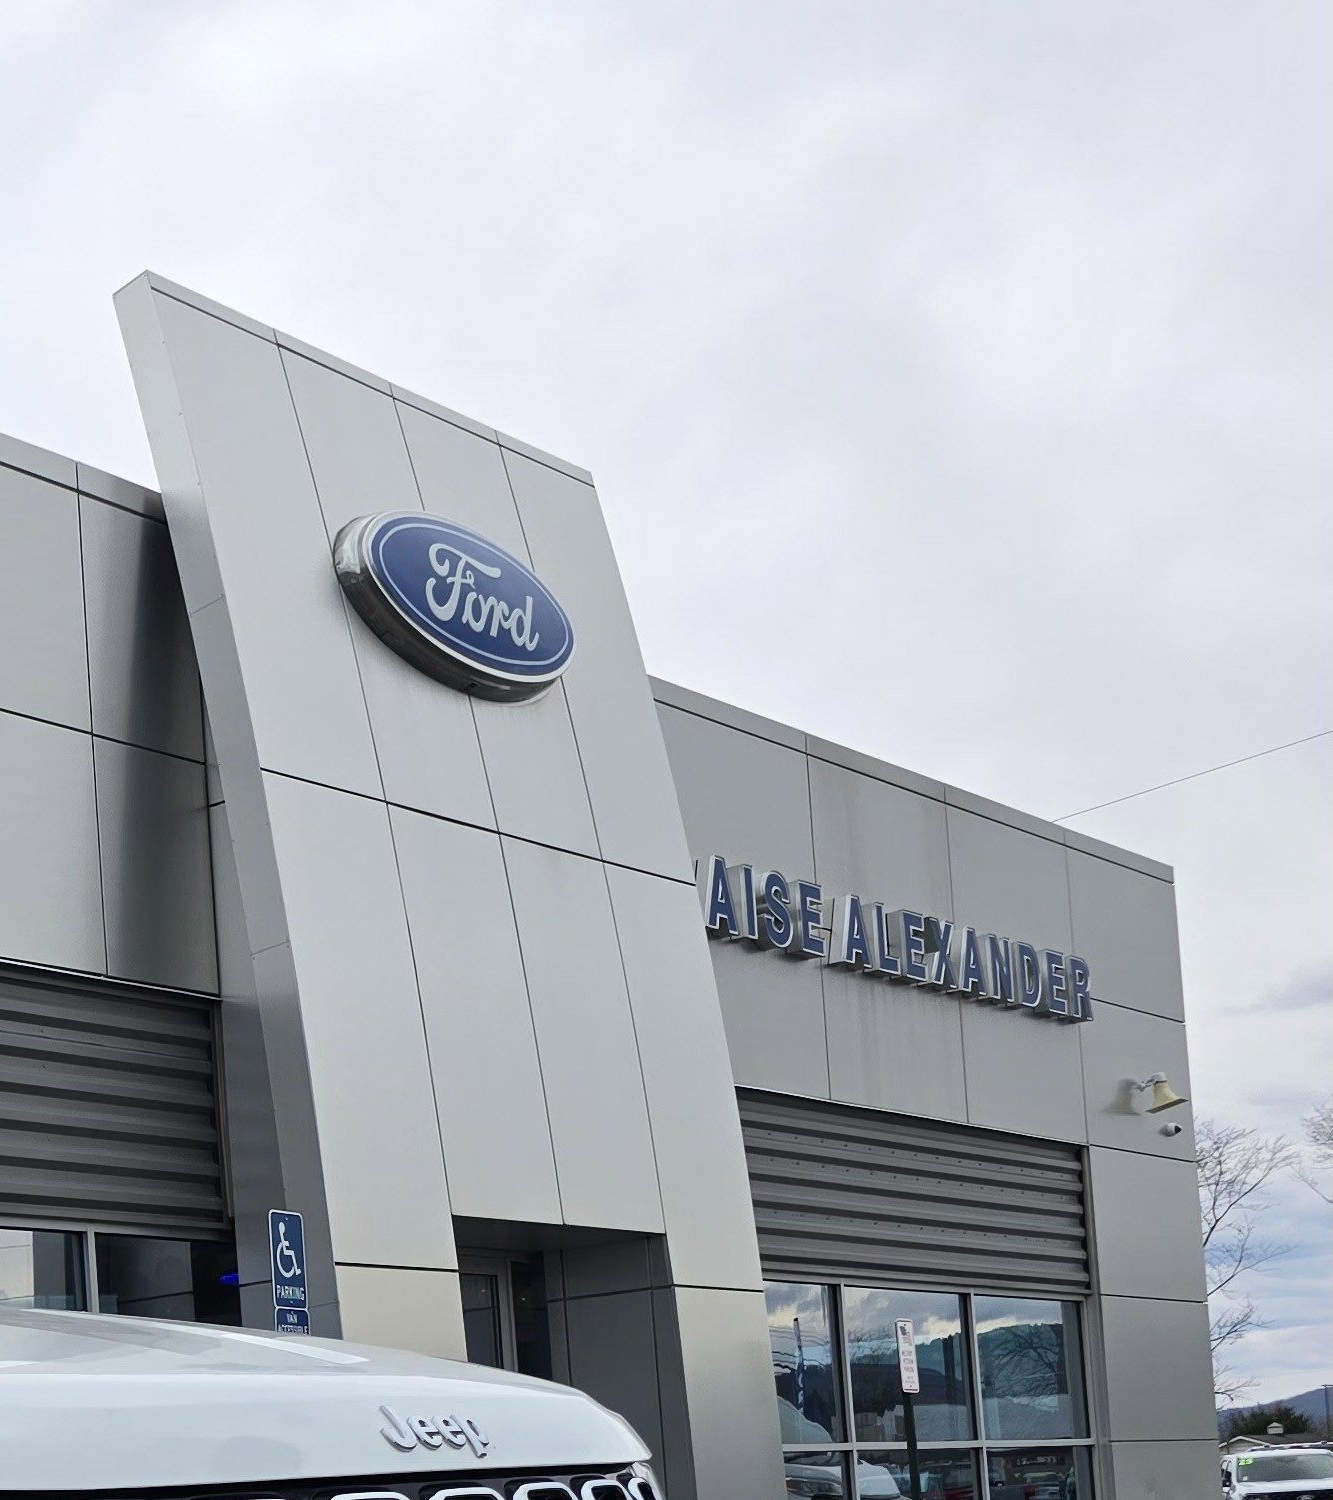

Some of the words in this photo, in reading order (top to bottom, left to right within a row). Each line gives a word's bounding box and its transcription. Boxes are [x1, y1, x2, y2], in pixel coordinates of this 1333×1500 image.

[425, 543, 540, 652] Ford
[704, 854, 826, 958] AISE
[842, 894, 1094, 1021] ALEXANDER
[276, 1285, 304, 1300] PARKING
[286, 1313, 298, 1323] VAN
[379, 1405, 490, 1458] Jeep
